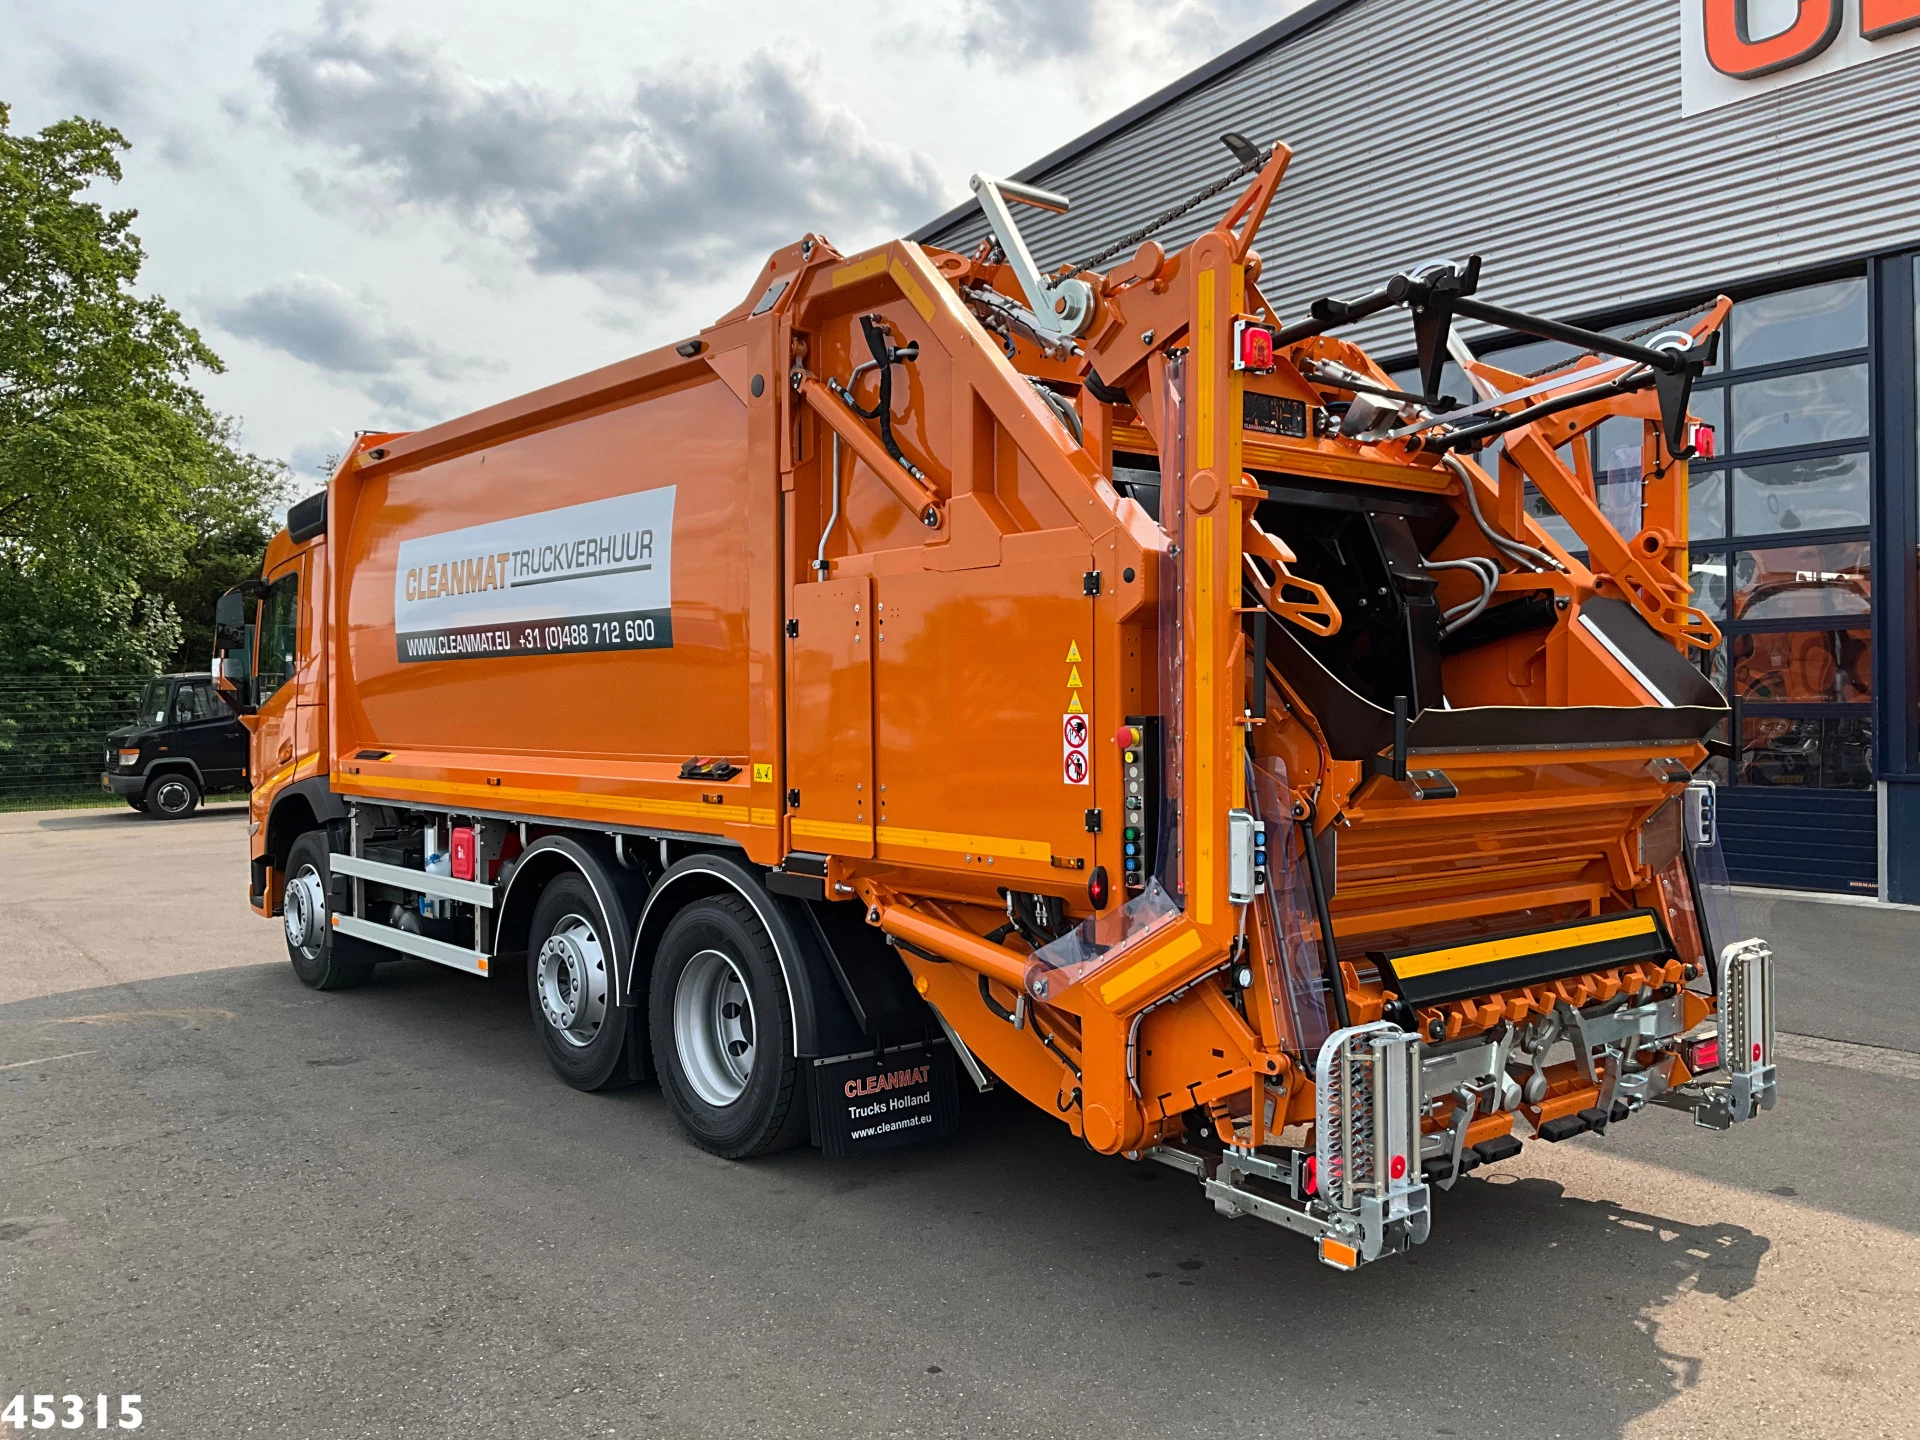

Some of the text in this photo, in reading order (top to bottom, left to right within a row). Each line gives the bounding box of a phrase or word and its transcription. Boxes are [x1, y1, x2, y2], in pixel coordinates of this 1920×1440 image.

[405, 528, 653, 602] CLEANMAT TRUCKVERHUUR
[406, 618, 655, 657] WWW.CLEANMAT.EU +31 (0)488 712 600
[844, 1065, 930, 1098] CLEANMAT
[848, 1091, 931, 1119] Trucks Holland
[850, 1114, 933, 1140] www.cleanmat.eu
